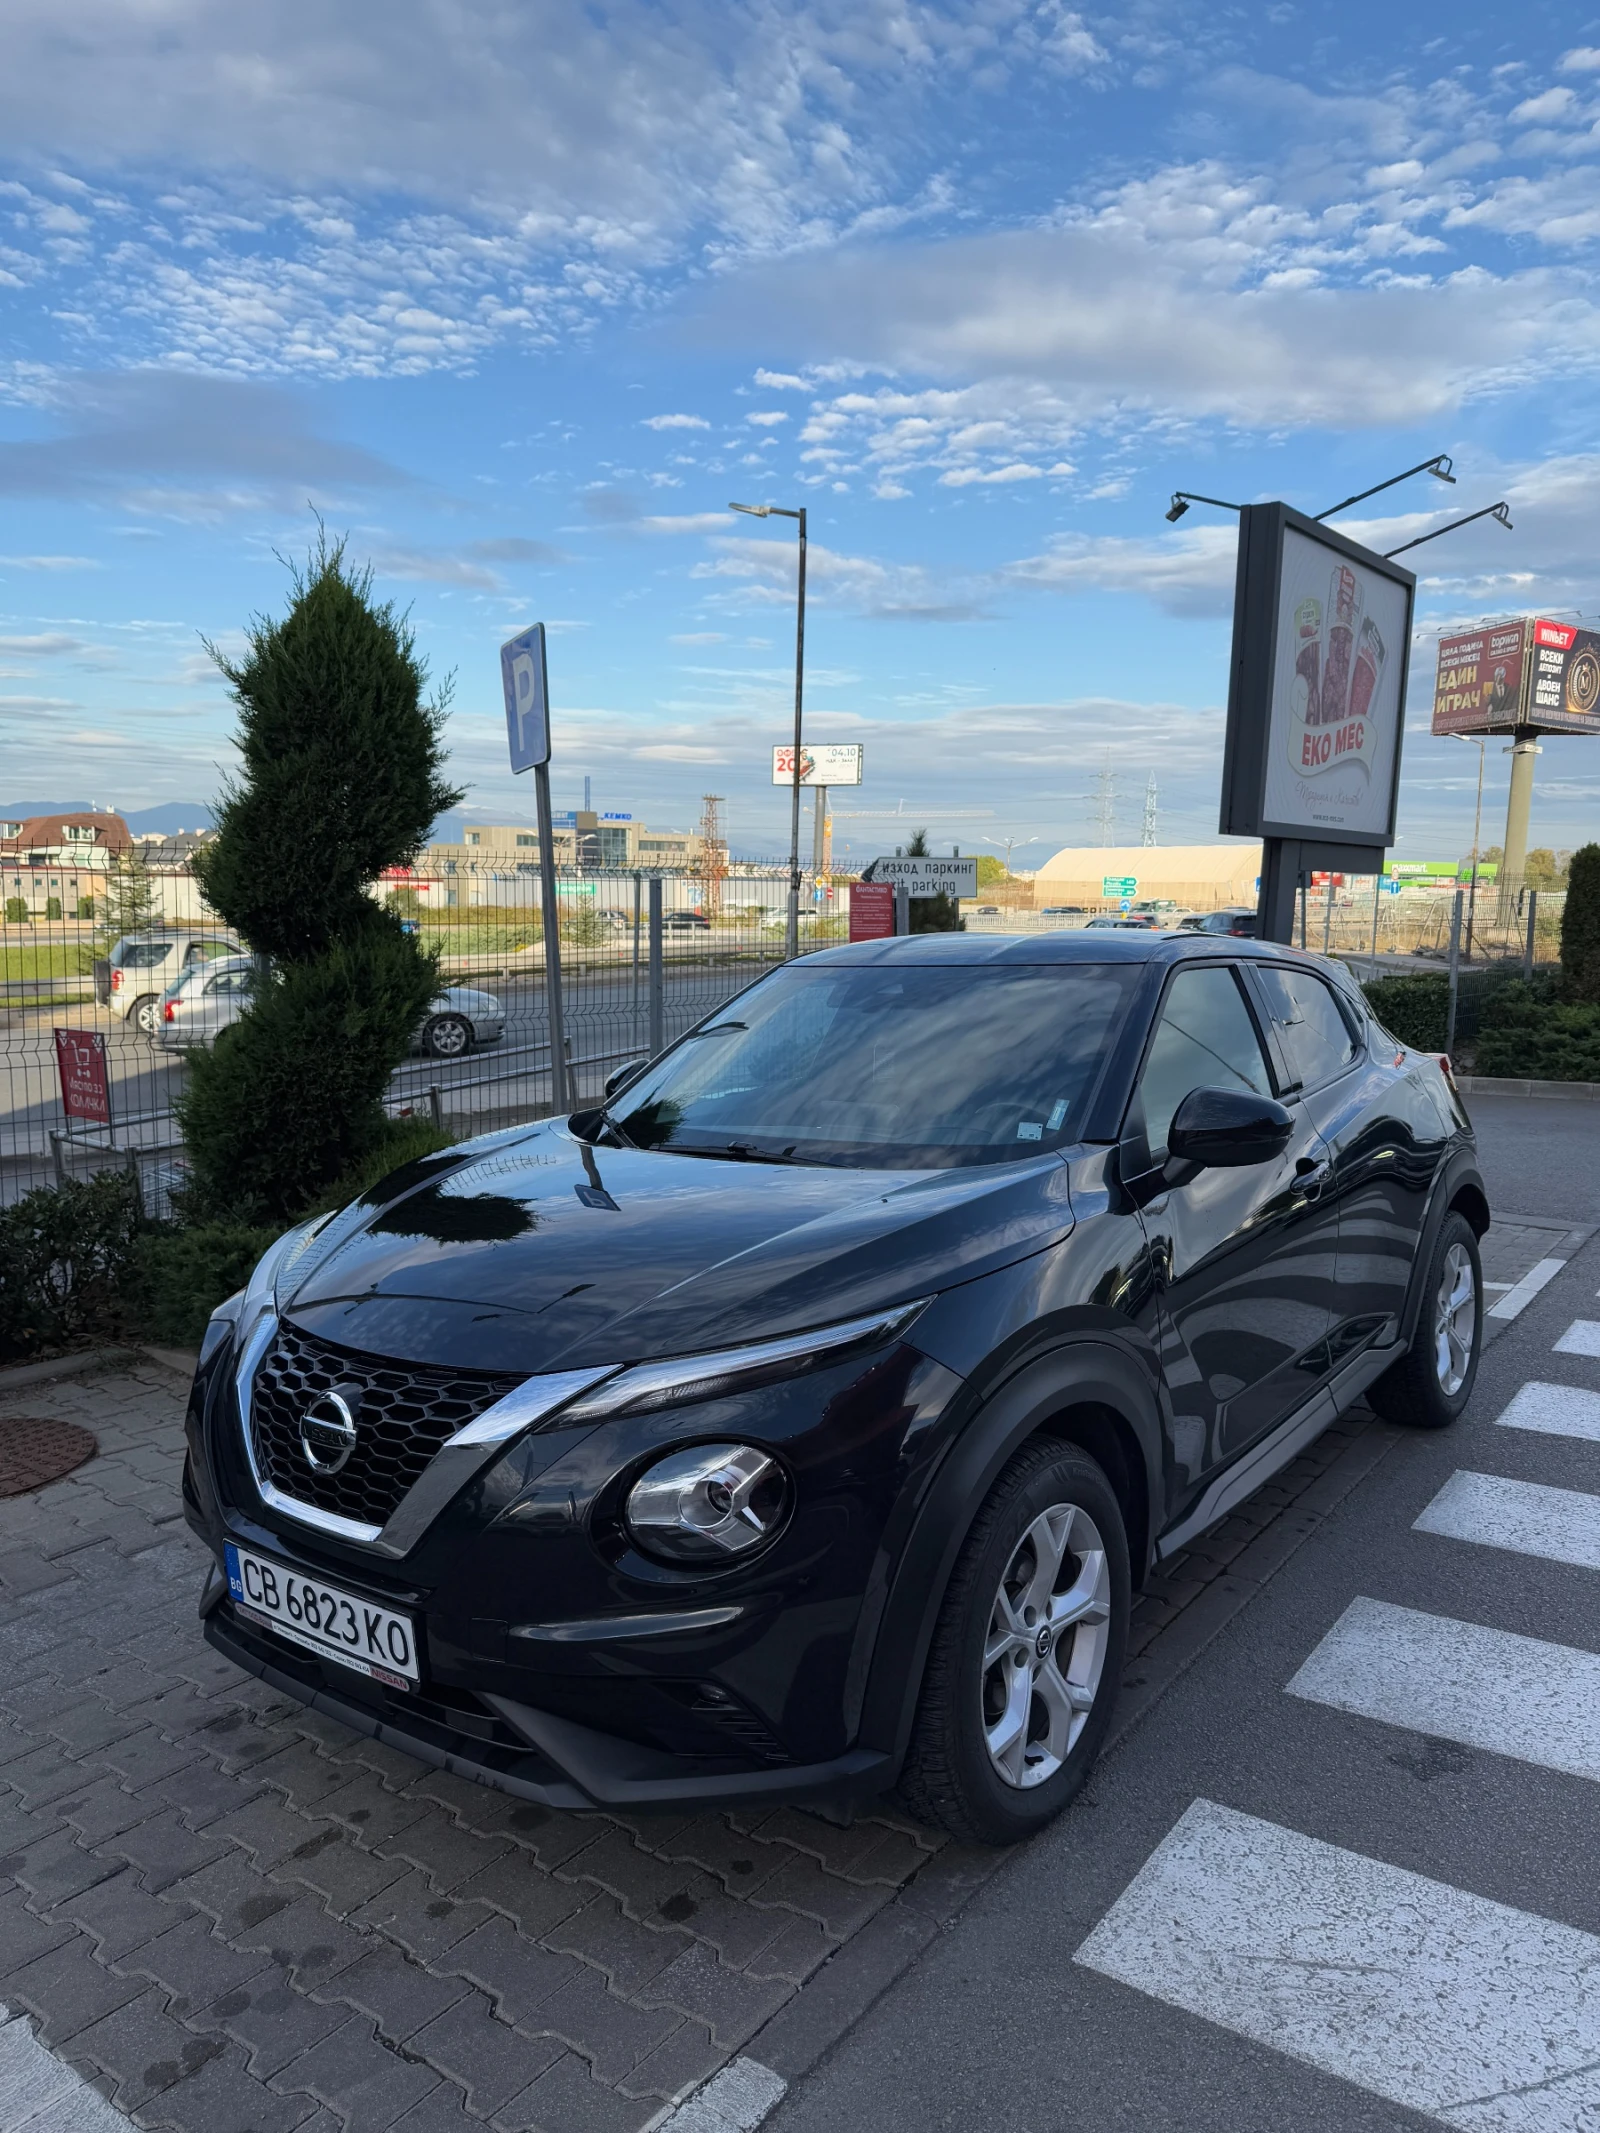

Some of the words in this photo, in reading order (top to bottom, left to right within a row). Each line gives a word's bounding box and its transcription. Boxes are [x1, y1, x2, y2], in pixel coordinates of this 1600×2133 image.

[1491, 632, 1519, 648] topwin
[1441, 646, 1458, 657] ЦЯЛА
[1459, 640, 1484, 653] ГОДИНА
[1440, 657, 1459, 668] ВСЕКИ
[1460, 652, 1481, 663] МЕСЕЦ
[1539, 649, 1564, 665] ВСЕКИ
[1538, 662, 1562, 674] ДЕПОЗИТ
[1438, 665, 1477, 691] ЕДИН
[1536, 679, 1561, 693] ДВОЕН
[1436, 690, 1481, 714] ИГРАЧ
[1535, 691, 1560, 707] ШАНС
[1301, 733, 1332, 766] ЕКО
[1334, 722, 1364, 756] МЕС
[832, 748, 857, 757] 04.10
[882, 863, 919, 875] изход
[925, 863, 974, 877] паркинг
[912, 878, 956, 894] parking
[230, 1577, 242, 1593] BG
[244, 1558, 280, 1610] CB
[286, 1578, 360, 1646] 6823
[364, 1608, 410, 1667] KO
[370, 1666, 408, 1690] NISSAN
